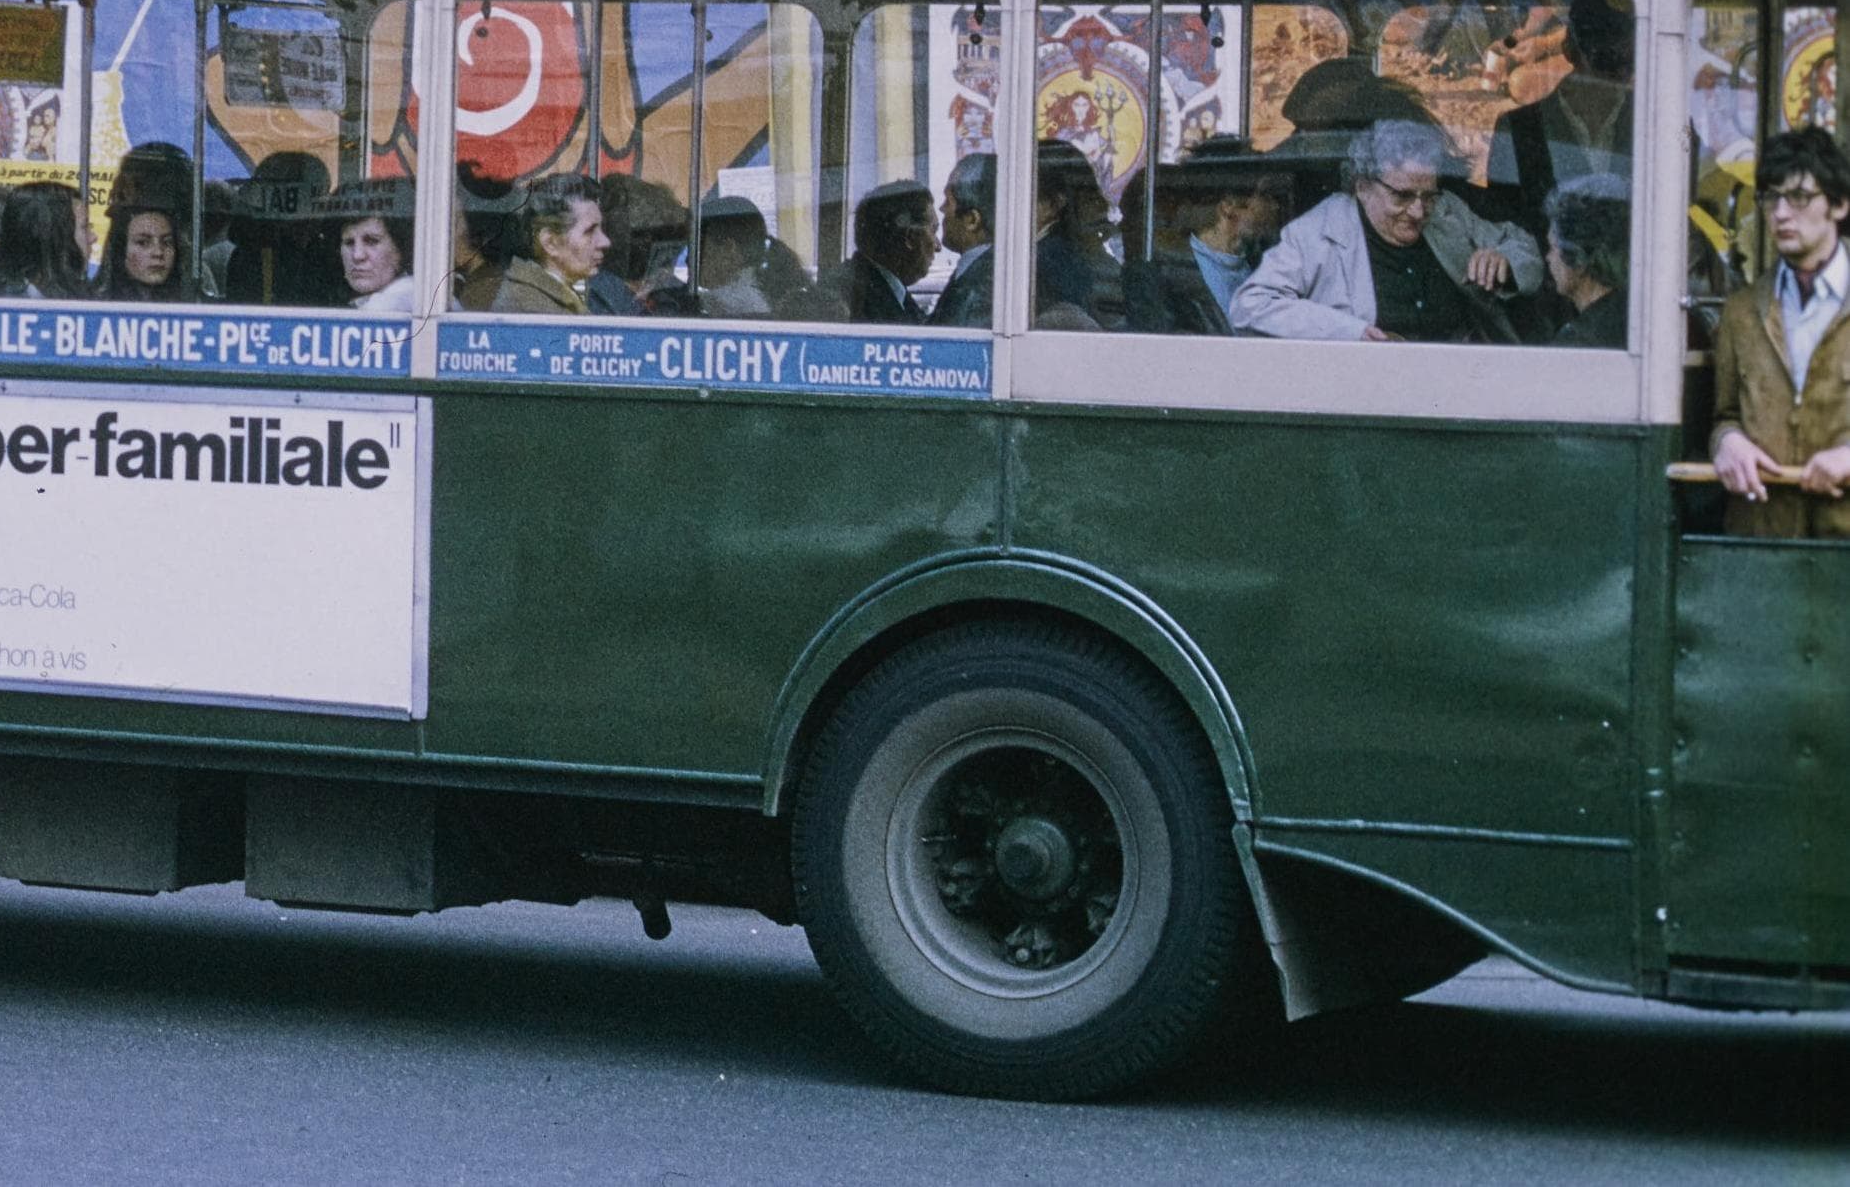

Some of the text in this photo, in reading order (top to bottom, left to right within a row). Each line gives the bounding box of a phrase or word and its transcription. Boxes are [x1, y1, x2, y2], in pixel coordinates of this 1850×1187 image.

[8, 168, 47, 179] partir
[49, 169, 64, 180] du
[55, 315, 203, 362] BLANCHE
[268, 346, 289, 365] DE
[291, 324, 408, 370] CLICHY
[469, 331, 491, 349] LA
[569, 333, 623, 355] PORTE
[439, 352, 517, 374] FOURCHE
[660, 336, 789, 382] CLICHY
[864, 343, 922, 364] PLACE
[551, 355, 642, 378] DE CLICHY
[43, 647, 55, 669] à
[61, 646, 86, 671] vis
